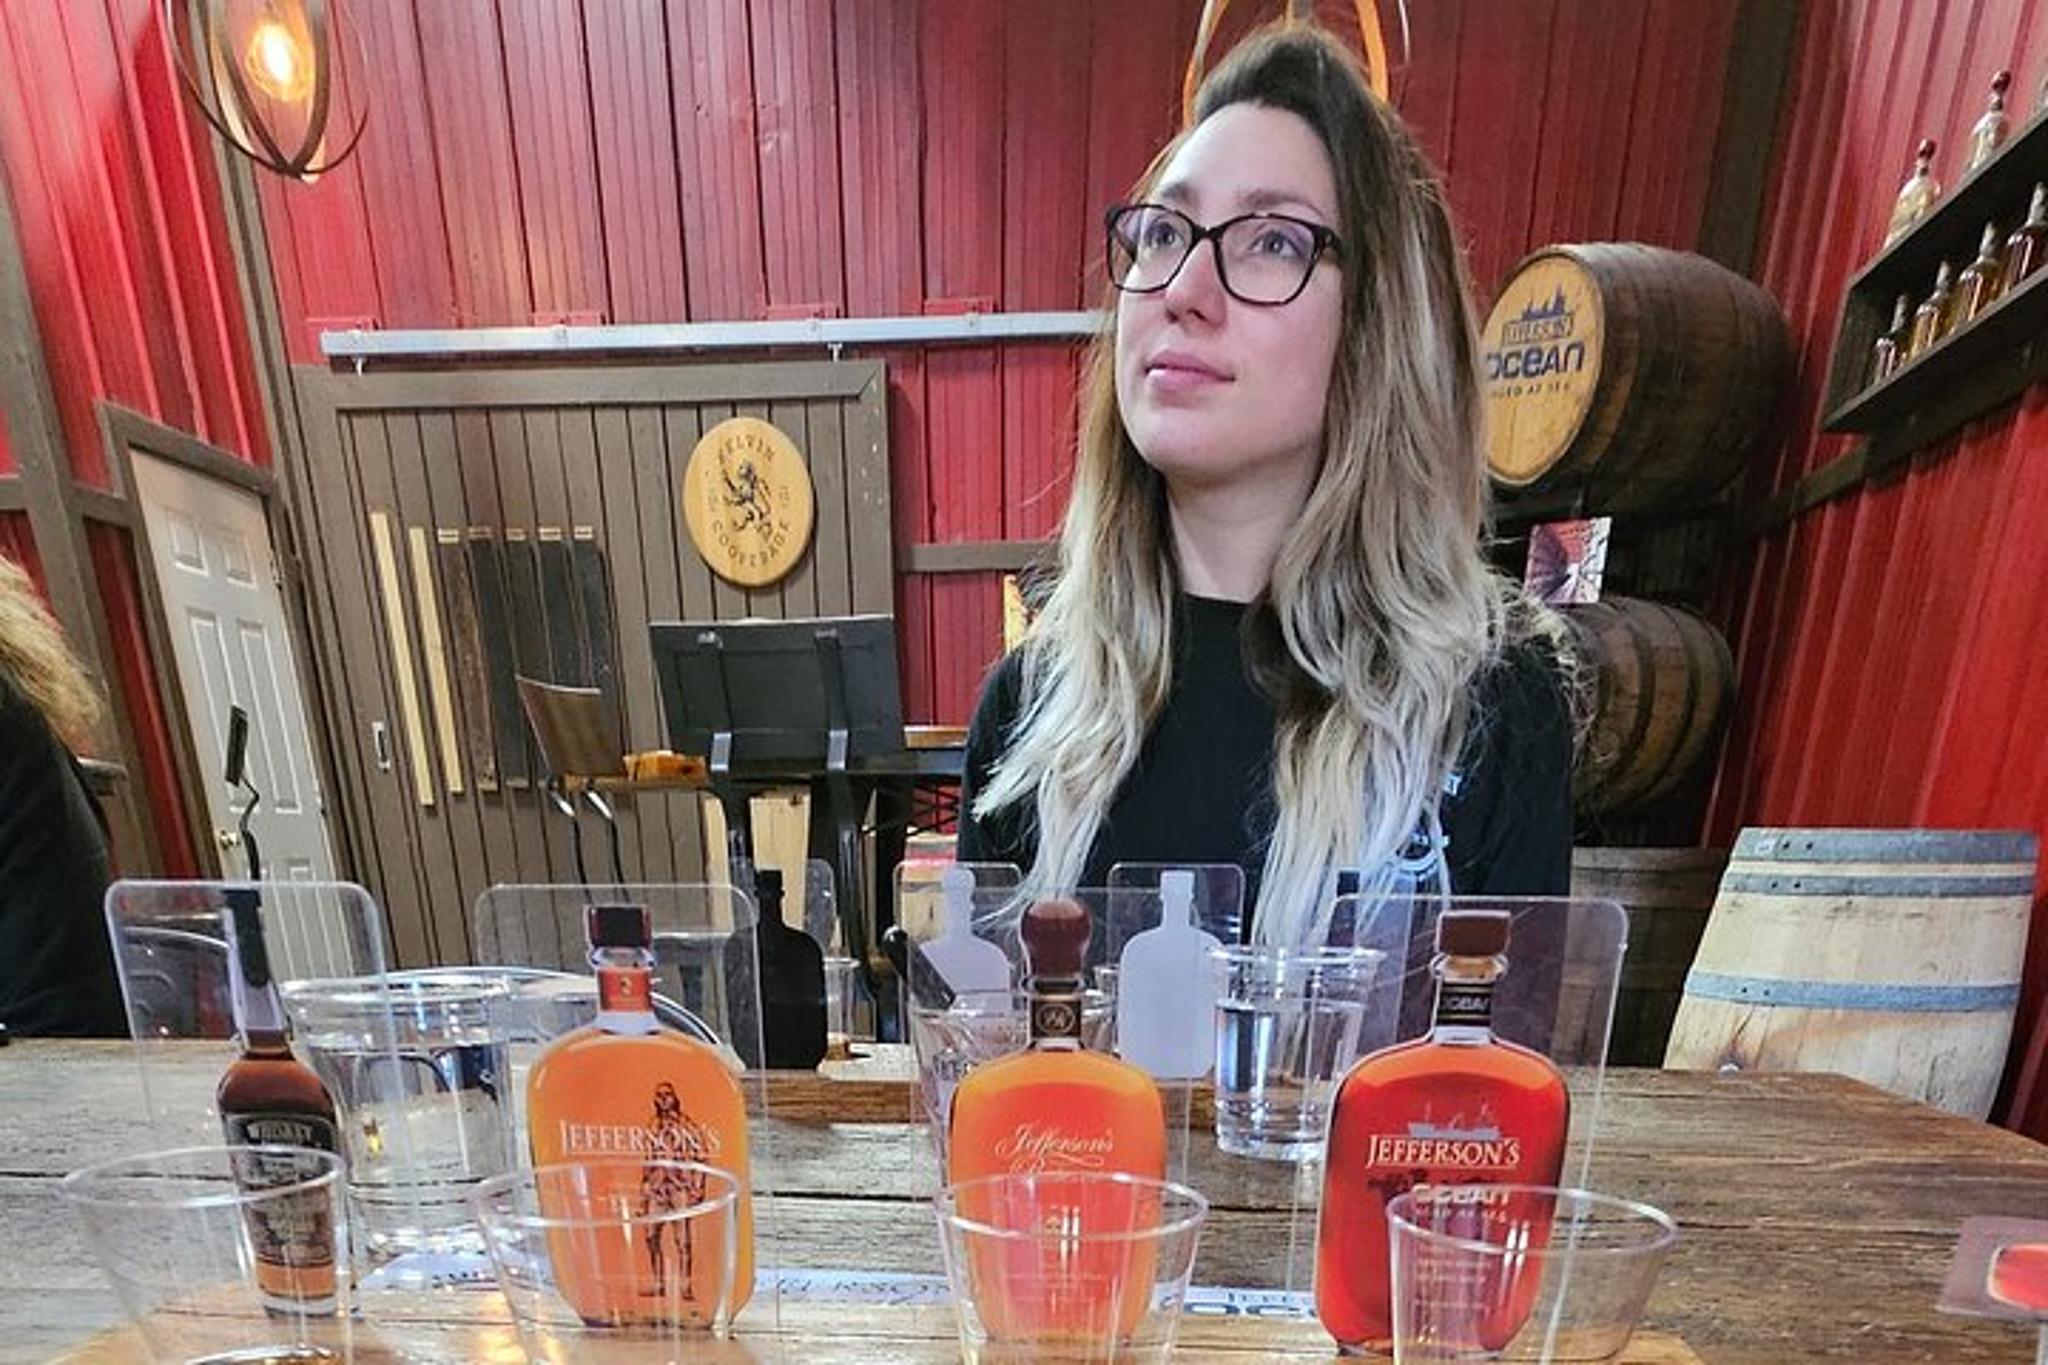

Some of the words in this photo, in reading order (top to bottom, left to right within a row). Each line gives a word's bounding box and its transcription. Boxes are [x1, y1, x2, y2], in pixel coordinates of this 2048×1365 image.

[711, 518, 791, 567] COOPERAGE
[559, 1119, 723, 1157] JEFFERSON'S
[994, 1120, 1115, 1166] Jefferson's
[1364, 1134, 1521, 1170] JEFFERSON'S
